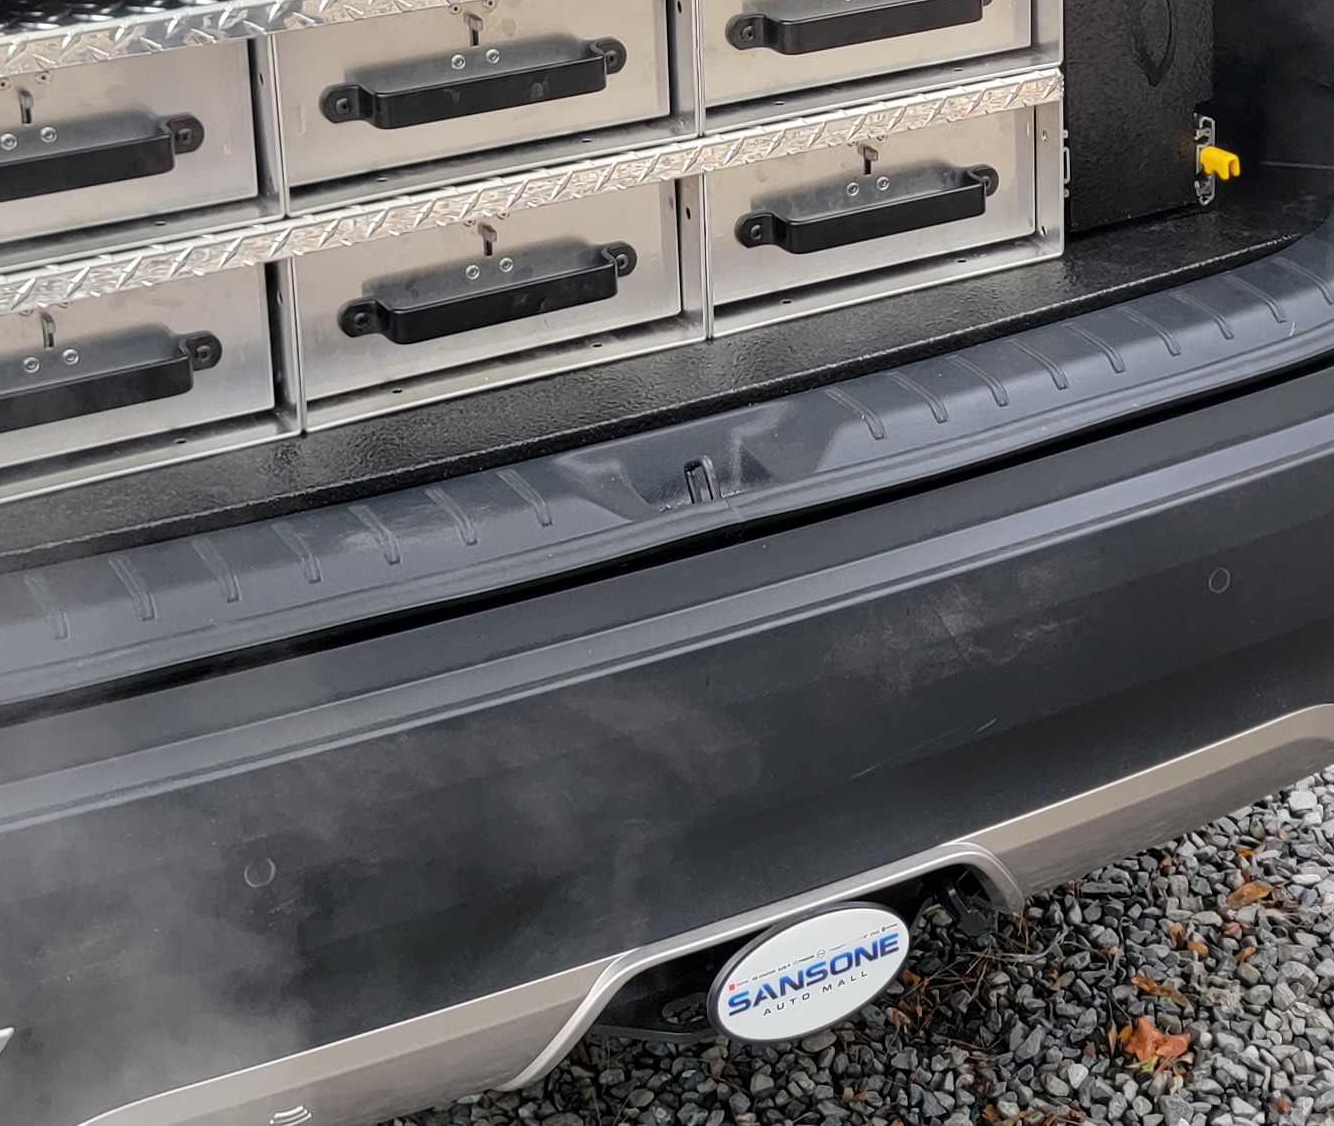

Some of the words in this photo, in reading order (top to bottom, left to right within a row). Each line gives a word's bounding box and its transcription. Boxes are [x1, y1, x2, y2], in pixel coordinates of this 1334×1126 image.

[728, 933, 899, 1017] SANSONE
[763, 992, 811, 1017] AUTO
[822, 970, 868, 993] MALL
